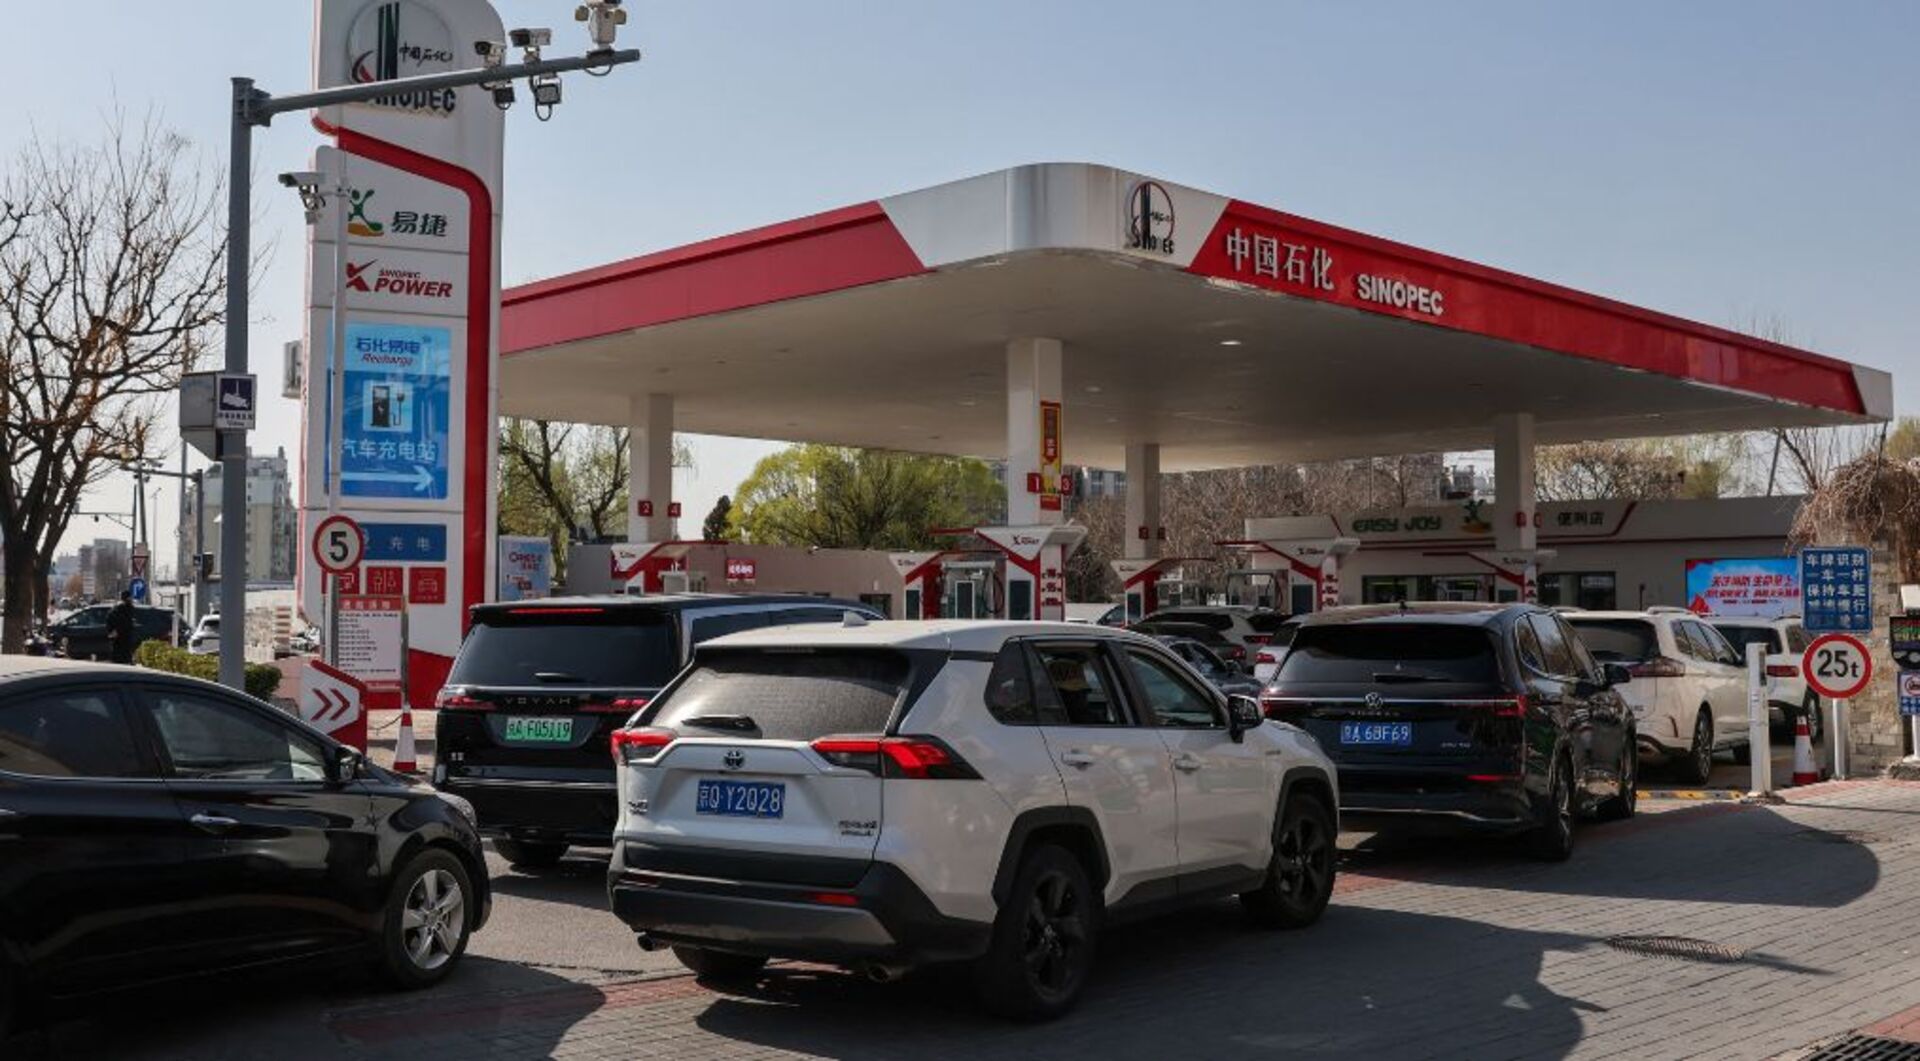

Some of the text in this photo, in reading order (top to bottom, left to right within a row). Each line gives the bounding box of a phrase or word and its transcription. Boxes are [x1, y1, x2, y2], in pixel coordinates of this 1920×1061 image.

[391, 211, 447, 237] 易捷
[1226, 227, 1335, 290] 中国石化
[379, 268, 421, 279] SINOPEC
[374, 278, 453, 297] POWER
[1358, 274, 1443, 315] SINOPEC
[356, 337, 421, 355] 石化易电
[340, 437, 438, 462] 汽车充电站
[1352, 516, 1441, 533] EASY JOY
[328, 531, 348, 562] 5
[1806, 554, 1864, 567] 车牌识别
[1806, 570, 1864, 581] 一车一杆
[1807, 584, 1866, 597] 保持车距
[1818, 650, 1859, 678] 25t
